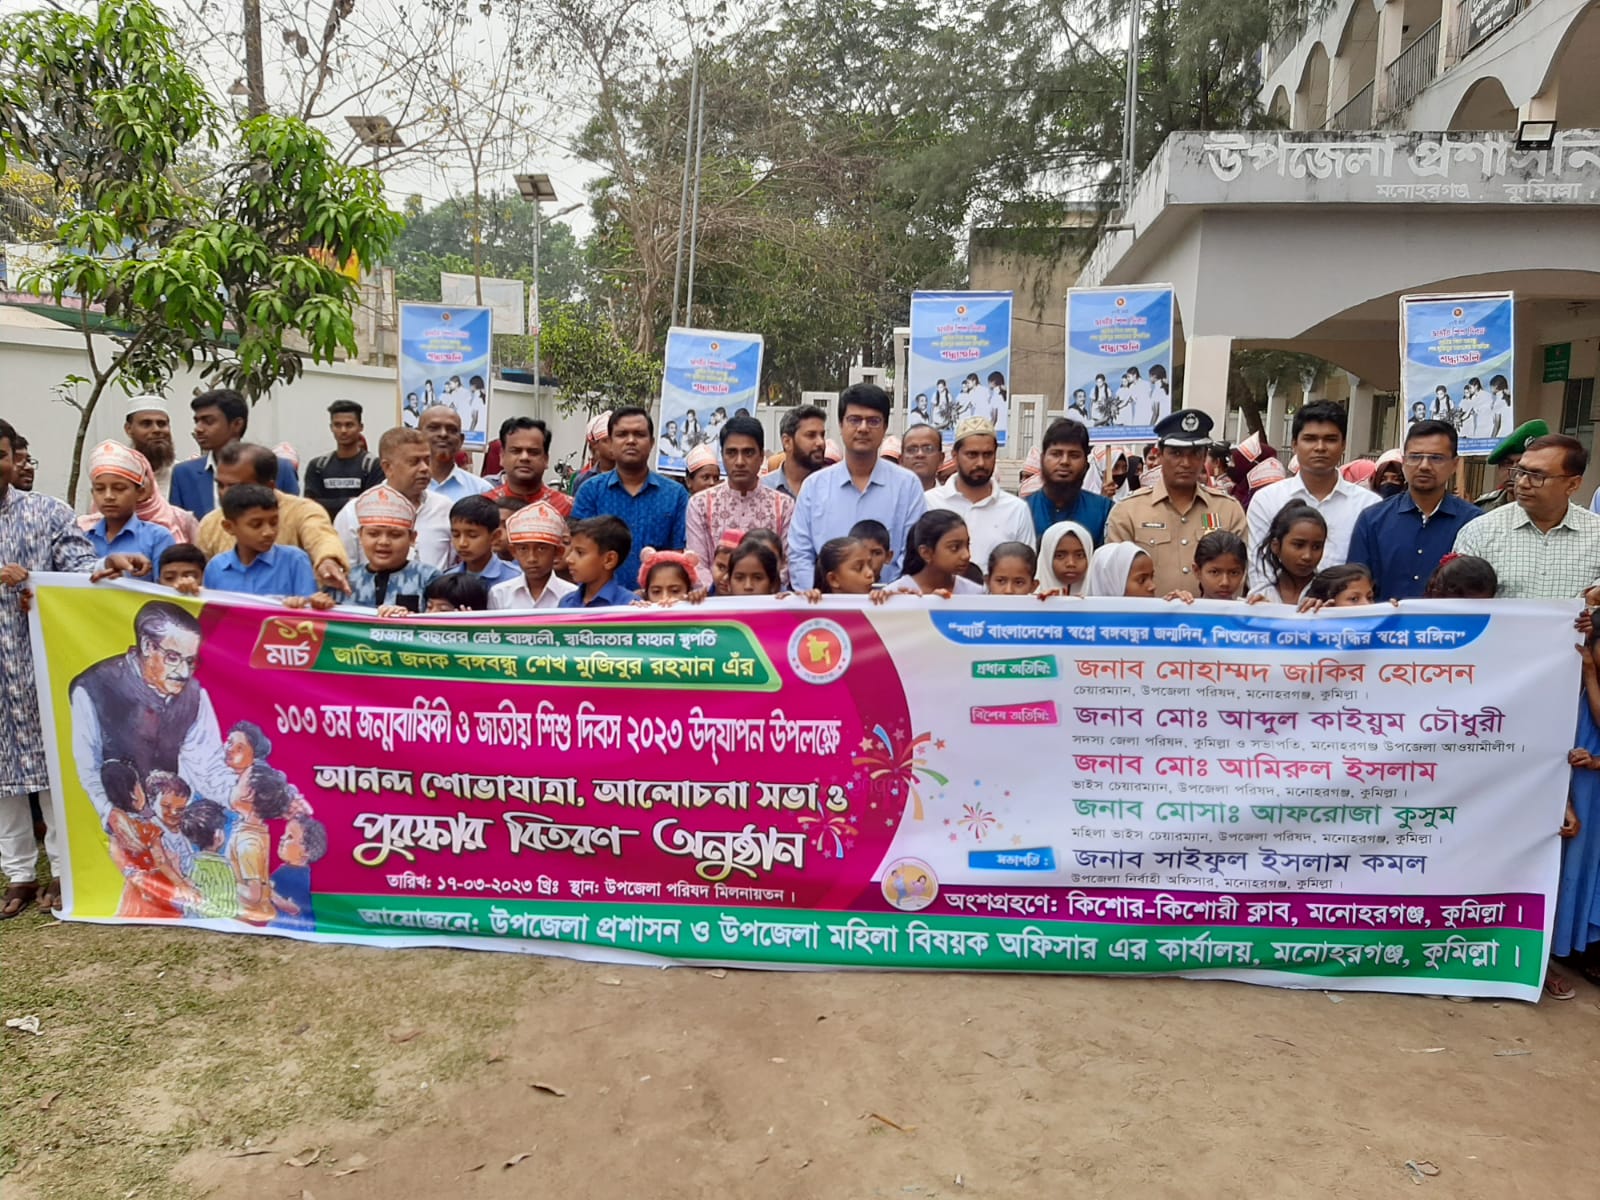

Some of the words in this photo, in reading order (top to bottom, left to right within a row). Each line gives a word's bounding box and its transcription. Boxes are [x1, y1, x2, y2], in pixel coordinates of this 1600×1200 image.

[1203, 132, 1397, 182] উপজেলা
[275, 620, 318, 640] ১৭
[369, 627, 414, 643] হাজার
[417, 629, 469, 645] বছরের
[473, 628, 501, 645] শ্রেষ্ঠ
[564, 629, 633, 648] স্বাধীনতার
[637, 633, 674, 648] মহান
[678, 629, 717, 650] স্থপতি
[988, 625, 1063, 640] বাংলাদেশের
[1067, 625, 1096, 641] স্বপ্নে
[1100, 625, 1149, 644] বঙ্গবন্ধুর
[1153, 623, 1207, 644] জন্মদিন,
[1211, 623, 1270, 645] শিশুদের
[1277, 629, 1311, 646] চোখ
[1317, 628, 1371, 650] সমৃদ্ধির
[1377, 630, 1408, 647] স্বপ্নে
[263, 642, 311, 666] মার্চ
[331, 644, 392, 667] জাতির
[397, 651, 449, 669] জনক
[453, 654, 518, 677] বঙ্গবন্ধু
[526, 654, 567, 674] শেখ
[576, 651, 642, 678] মুজিবুর
[649, 656, 715, 677] রহমান
[722, 651, 755, 677] এঁর
[977, 661, 1006, 675] প্রধান
[1075, 658, 1144, 680] জনাব
[1156, 659, 1271, 684] মোহাম্মদ
[1281, 658, 1366, 684] জাকির
[1379, 661, 1475, 686] হোসেন
[1141, 685, 1190, 697] উপজেলা
[1320, 688, 1358, 701] কুমিল্লা
[274, 703, 317, 734] ১০৩
[320, 705, 352, 739] তম
[356, 695, 451, 752] জন্মবার্ষিকী
[456, 711, 470, 744] ও
[474, 698, 531, 749] জাতীয়
[536, 700, 571, 751] শিশু
[576, 701, 622, 749] দিবস
[627, 715, 683, 754] ২০২৩
[769, 708, 842, 755] উপলক্ষে
[972, 707, 1006, 721] বিশেষ
[1073, 706, 1144, 728] জনাব
[1156, 707, 1207, 729] মোঃ
[1219, 709, 1299, 736] আব্দুল
[1309, 706, 1405, 737] কাইয়ুম
[1420, 706, 1506, 737] চৌধুরী
[1072, 735, 1104, 746] সদস্য
[1110, 735, 1139, 747] জেলা
[1193, 736, 1230, 749] কুমিল্লা
[1384, 740, 1436, 752] উপজেলা
[1441, 739, 1514, 752] আওয়ামীলীগ
[1072, 753, 1144, 775] জনাব
[1155, 755, 1208, 777] মোঃ
[1218, 753, 1333, 780] আমিরুল
[1343, 755, 1438, 783] ইসলাম
[312, 765, 413, 796] আনন্দ
[420, 772, 585, 807] শোভাযাত্রা,
[592, 779, 750, 809] আলোচনা
[756, 782, 818, 811] সভা
[825, 784, 849, 812] ও
[1072, 779, 1104, 790] ভাইস
[1177, 782, 1229, 794] উপজেলা
[1360, 787, 1397, 800] কুমিল্লা
[1072, 798, 1144, 820] জনাব
[1155, 800, 1239, 824] মোসাঃ
[1251, 803, 1382, 825] আফরোজা
[1392, 805, 1458, 829] কুসুম
[502, 811, 640, 855] বিতরণ
[653, 818, 806, 880] অনুষ্ঠান
[1071, 826, 1106, 839] মহিলা
[1112, 829, 1143, 840] ভাইস
[1218, 831, 1268, 843] উপজেলা
[1395, 832, 1432, 845] কুমিল্লা
[1072, 848, 1144, 870] জনাব
[1153, 847, 1248, 877] সাইফুল
[1258, 846, 1350, 875] ইসলাম
[1360, 854, 1428, 874] কমল
[437, 876, 532, 893] ১৭-০৩-২০২৩
[604, 877, 661, 897] উপজেলা
[667, 880, 708, 899] পরিষদ
[715, 882, 784, 902] মিলনায়তন
[1071, 872, 1120, 884] উপজেলা
[1125, 872, 1160, 885] নির্বাহী
[1297, 878, 1333, 889] কুমিল্লা
[1066, 889, 1239, 921] কিশোর-কিশোরী
[1246, 902, 1298, 926] ক্লাব,
[1306, 902, 1431, 929] মনোহরগঞ্জ,
[1440, 899, 1505, 928] কুমিল্লা
[489, 905, 589, 941] উপজেলা
[596, 914, 682, 945] প্রশাসন
[690, 921, 709, 943] ও
[718, 911, 820, 949] উপজেলা
[826, 917, 898, 954] মহিলা
[907, 920, 989, 957] বিষয়ক
[997, 925, 1098, 961] অফিসার
[1109, 938, 1148, 962] এর
[1155, 931, 1260, 966] কার্যালয়,
[1270, 940, 1410, 969] মনোহরগঞ্জ,
[1422, 934, 1499, 970] কুমিল্লা
